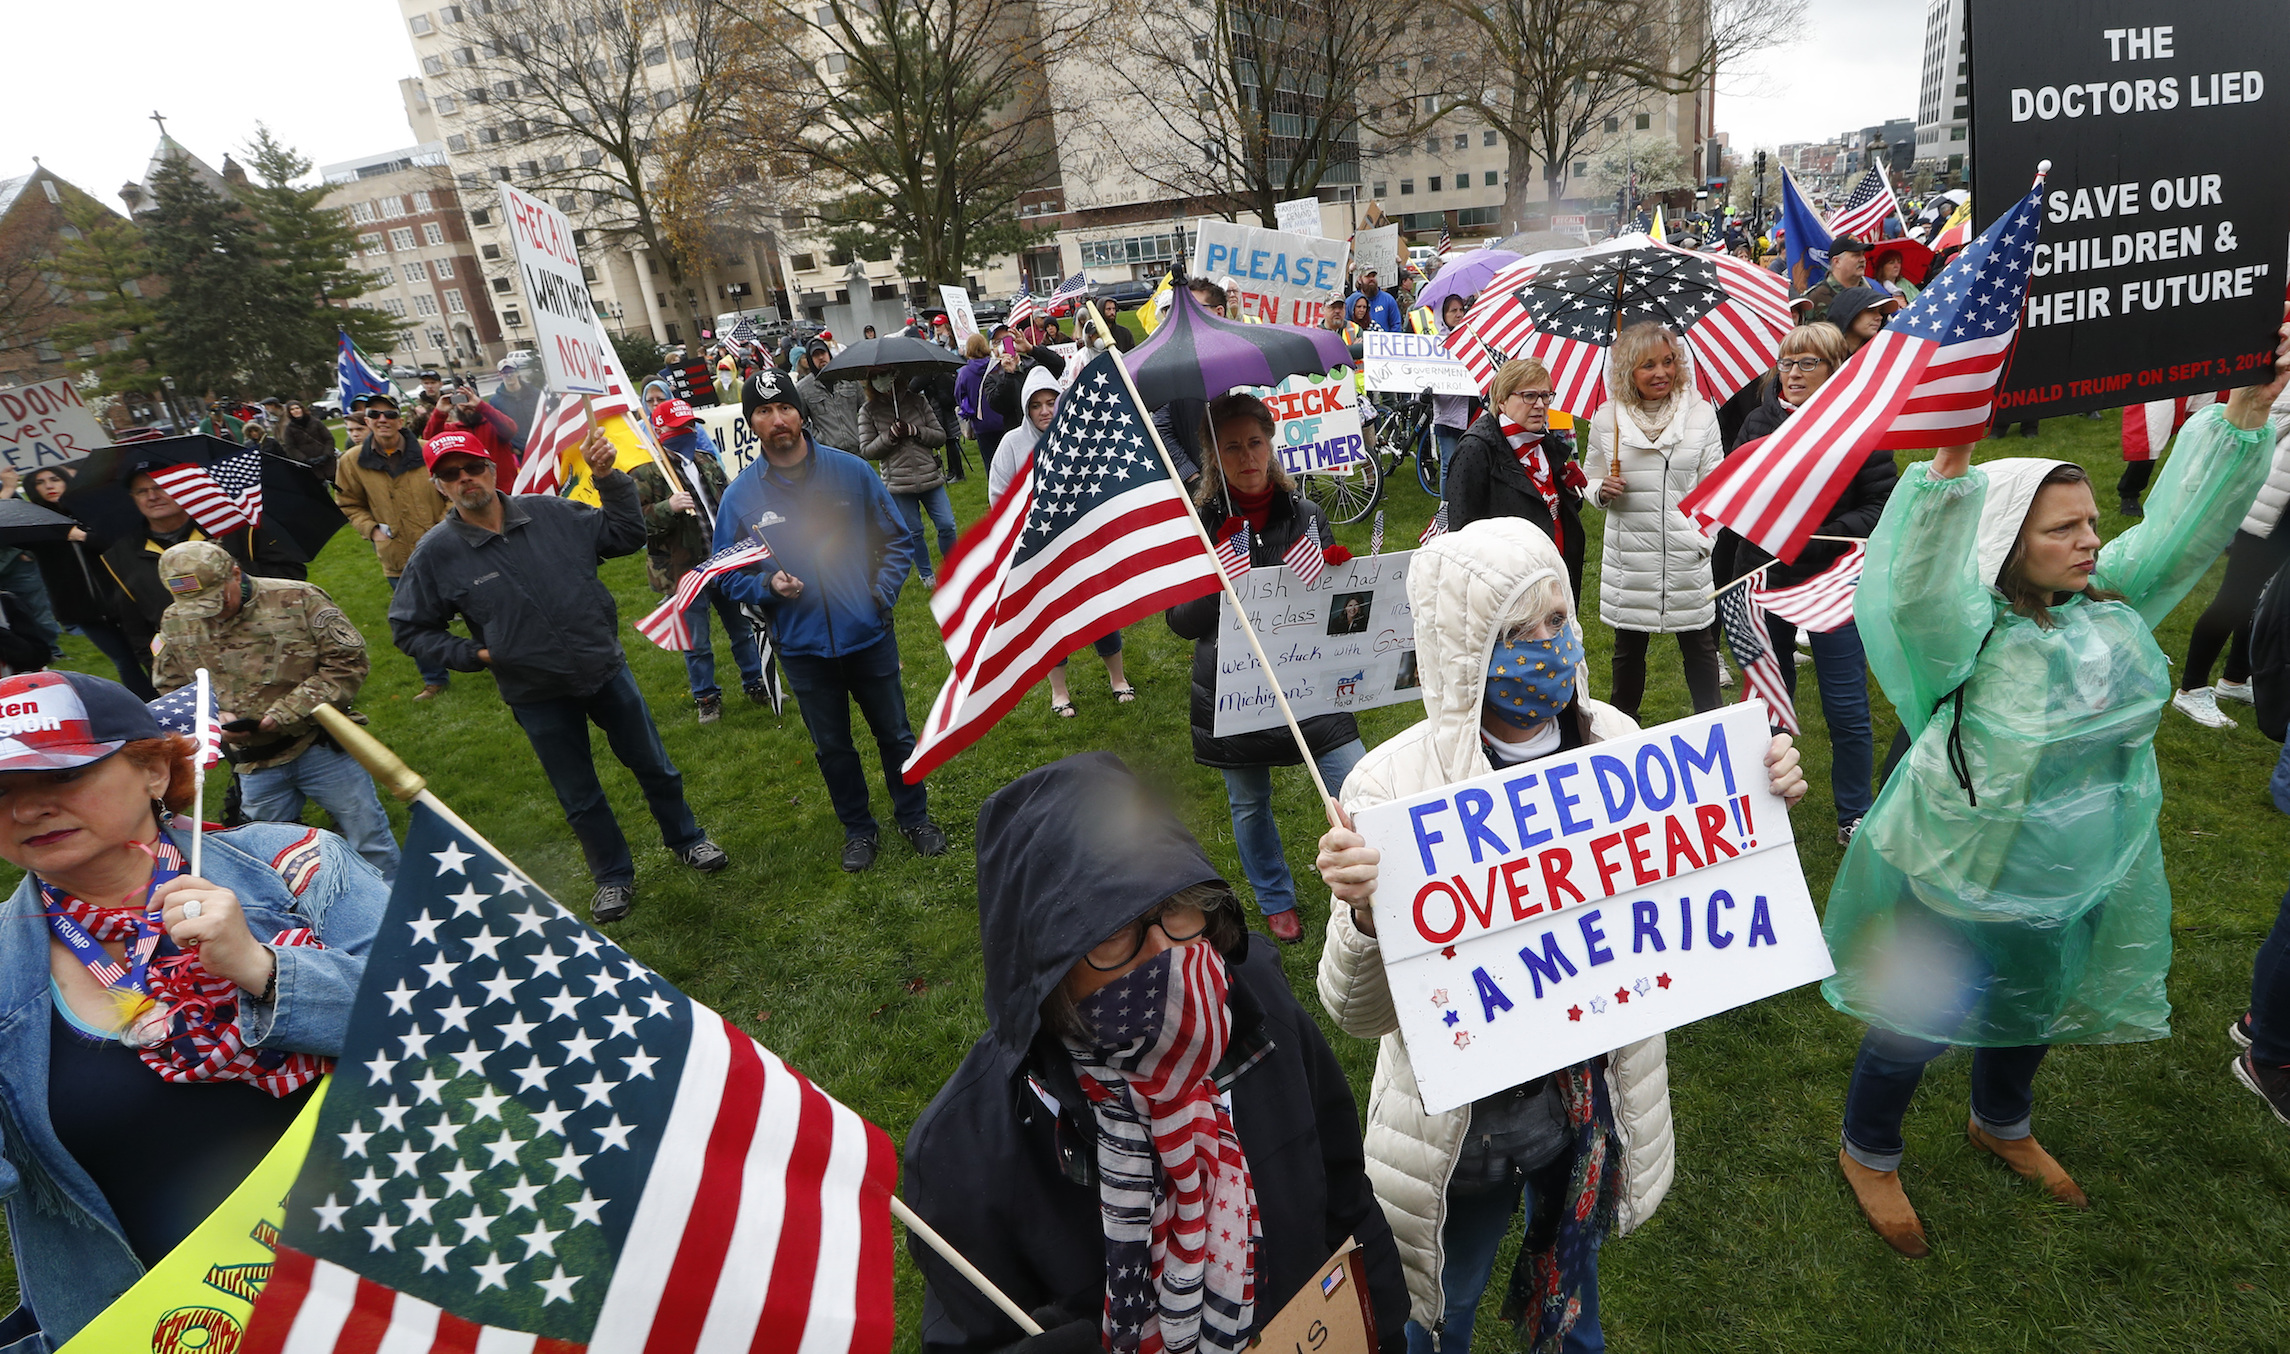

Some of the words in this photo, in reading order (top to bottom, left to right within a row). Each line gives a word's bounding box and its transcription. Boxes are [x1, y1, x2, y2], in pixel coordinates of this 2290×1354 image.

[2104, 25, 2174, 62] THE
[2011, 77, 2179, 122] DOCTORS
[2190, 70, 2264, 107] LIED
[2048, 182, 2140, 222] SAVE
[2150, 174, 2223, 212] OUR
[509, 191, 577, 267] RECALL
[2032, 224, 2203, 277] CHILDREN
[2214, 220, 2238, 253] &
[1206, 243, 1337, 290] PLEASE
[2027, 286, 2111, 328] HEIR
[2121, 263, 2269, 314] FUTURE"
[1368, 361, 1394, 389] NOT
[1997, 384, 2064, 410] ONALD
[2068, 371, 2133, 395] TRUMP
[2137, 368, 2163, 388] ON
[2168, 360, 2213, 382] SEPT
[2216, 356, 2231, 376] 3,
[2235, 350, 2272, 372] 2014
[429, 435, 467, 450] Trump
[1346, 559, 1382, 588] had
[1392, 570, 1403, 581] a
[1272, 604, 1316, 627] class
[1334, 643, 1361, 657] with
[1408, 723, 1737, 877] FREEDOM
[1412, 847, 1587, 944] OVER
[1589, 794, 1758, 898] FEAR!!
[54, 915, 91, 950] TRUMP
[1471, 888, 1778, 1023] AMERICA
